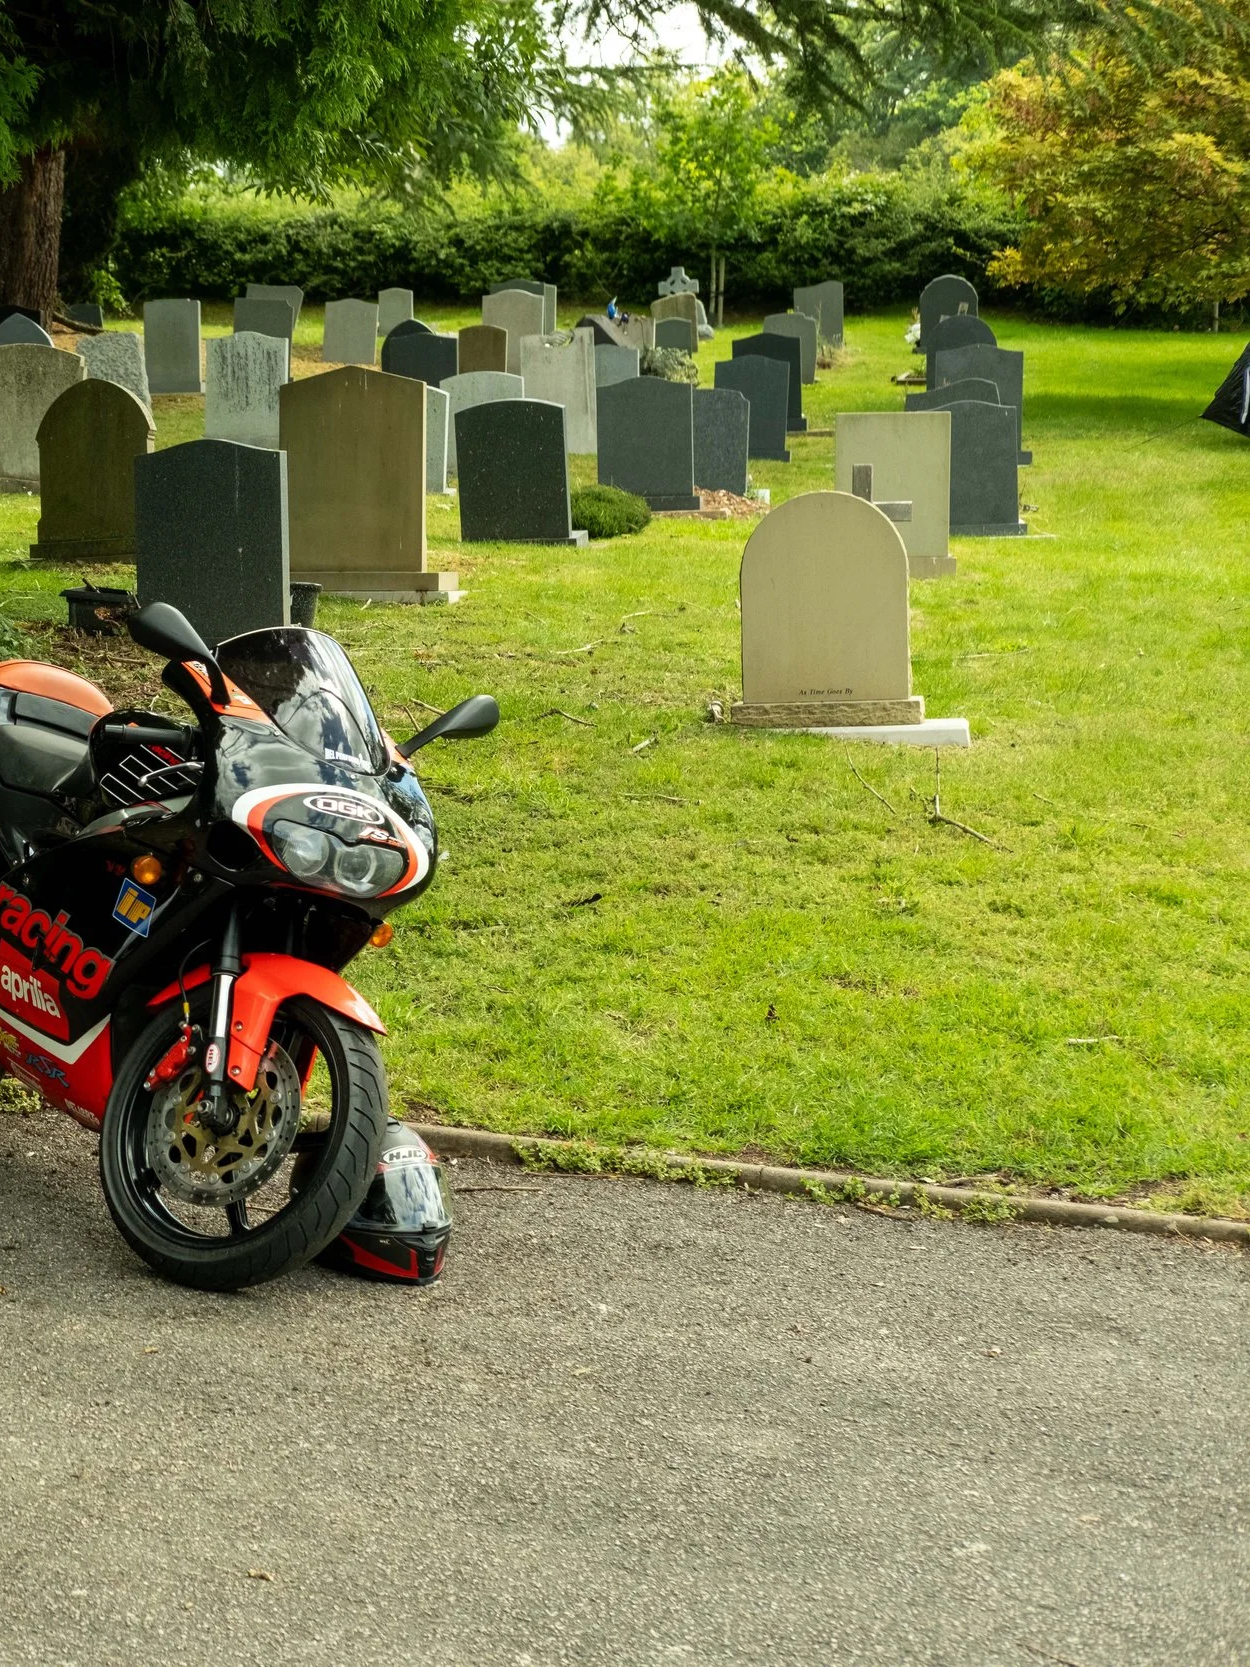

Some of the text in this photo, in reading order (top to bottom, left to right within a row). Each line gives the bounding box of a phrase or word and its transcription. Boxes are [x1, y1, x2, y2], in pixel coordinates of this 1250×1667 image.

[810, 688, 825, 696] Time
[845, 688, 853, 696] By
[316, 798, 375, 822] OGK
[0, 964, 61, 1019] aprilia
[388, 1149, 423, 1162] HJC
